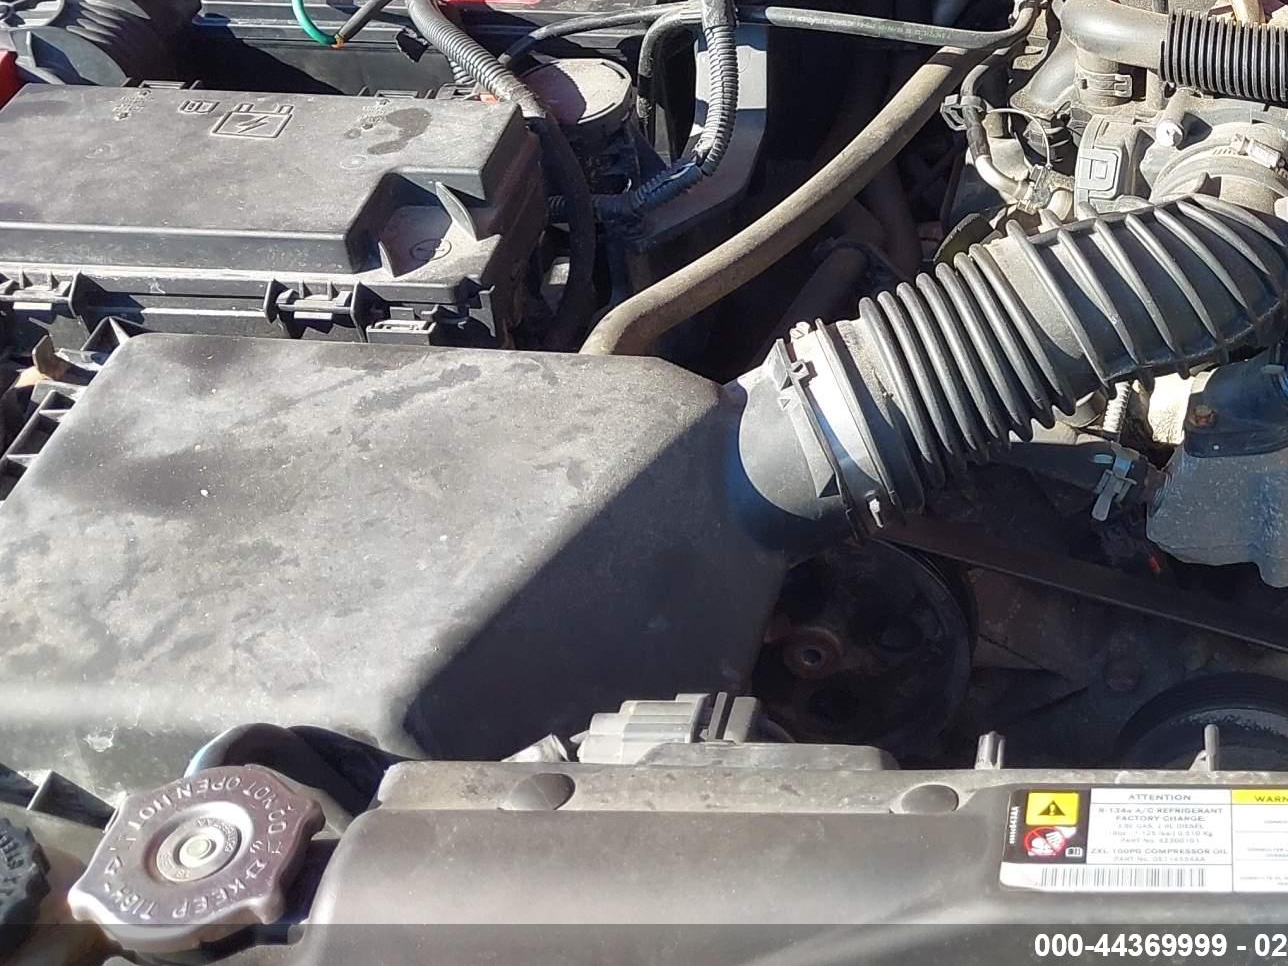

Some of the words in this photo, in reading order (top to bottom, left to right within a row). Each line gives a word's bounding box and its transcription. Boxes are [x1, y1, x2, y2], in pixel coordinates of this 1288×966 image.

[176, 776, 242, 798] OPEN
[127, 792, 172, 831] HOT
[172, 880, 247, 919] KEEP
